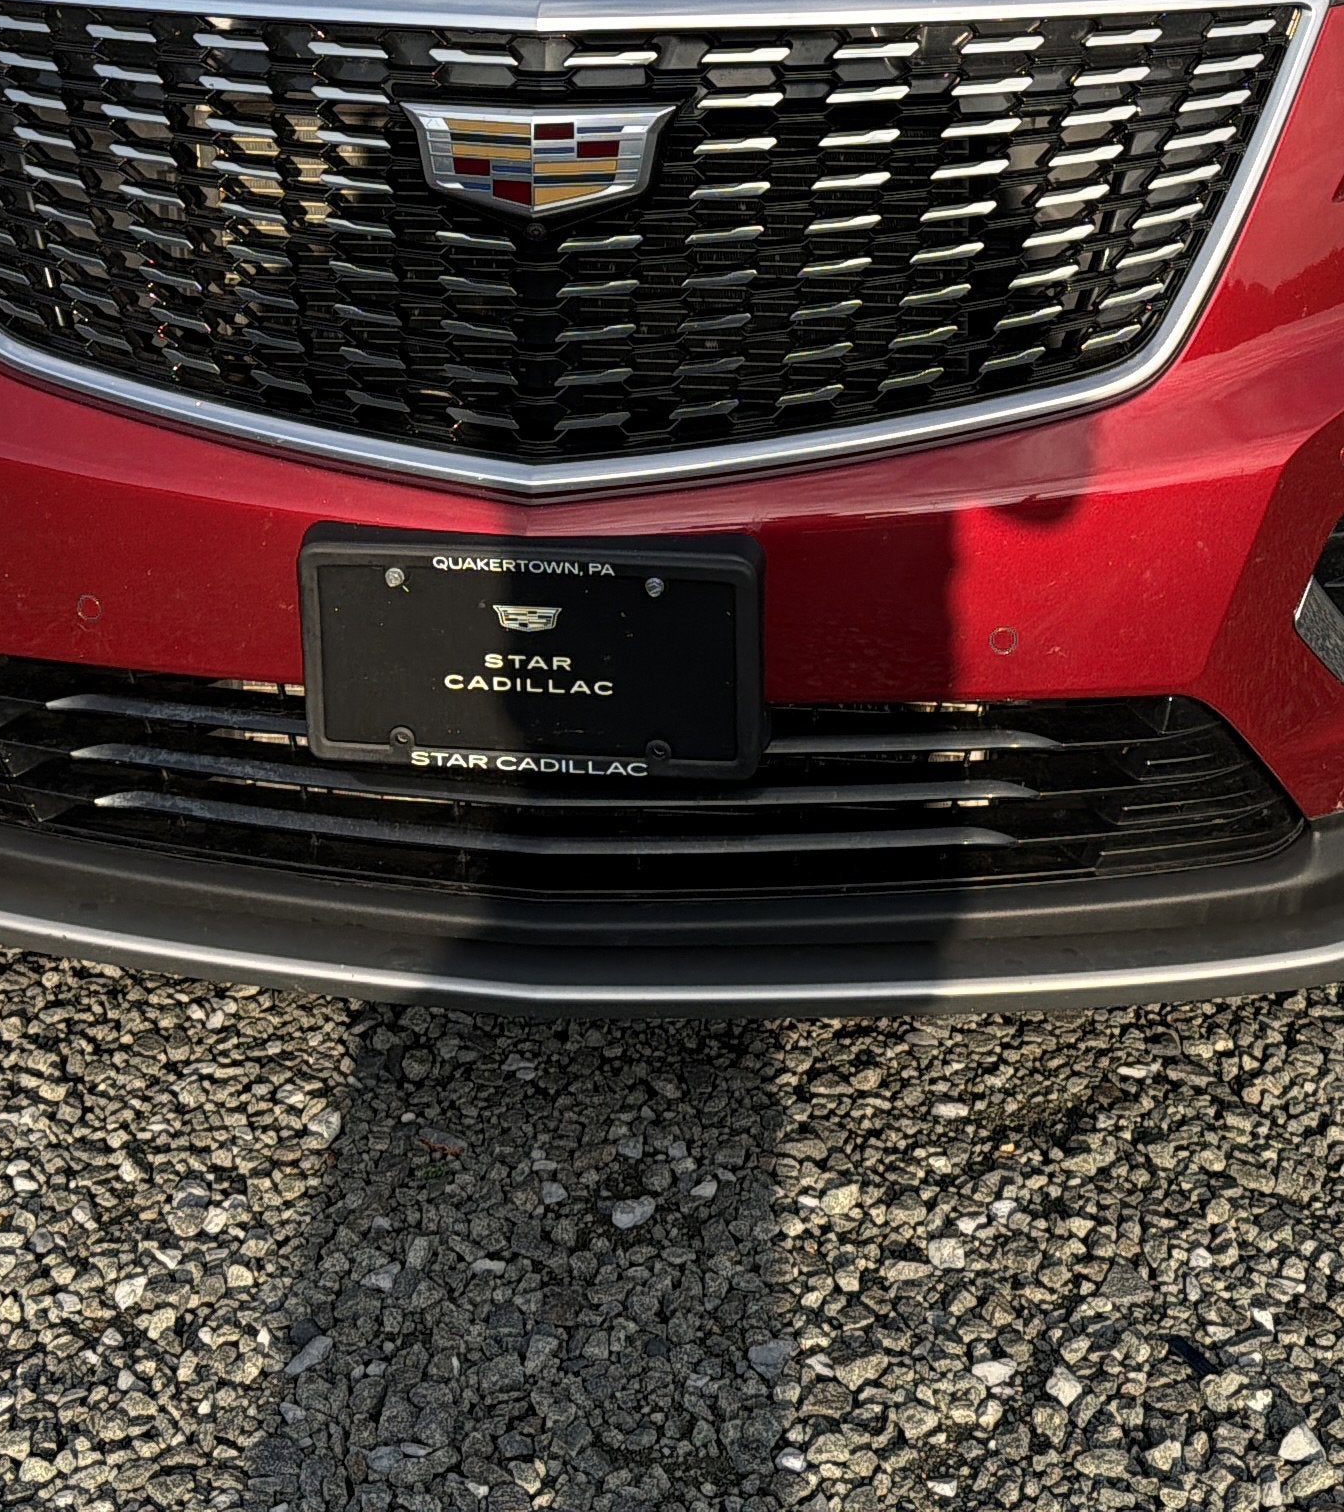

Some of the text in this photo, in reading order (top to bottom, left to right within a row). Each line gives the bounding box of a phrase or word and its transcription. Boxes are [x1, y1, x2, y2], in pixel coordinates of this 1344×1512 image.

[432, 556, 616, 577] QUAKERTOWN, PA
[484, 653, 572, 671] STAR
[444, 674, 614, 696] CADILLAC
[411, 751, 649, 777] STAR CADILLAC
